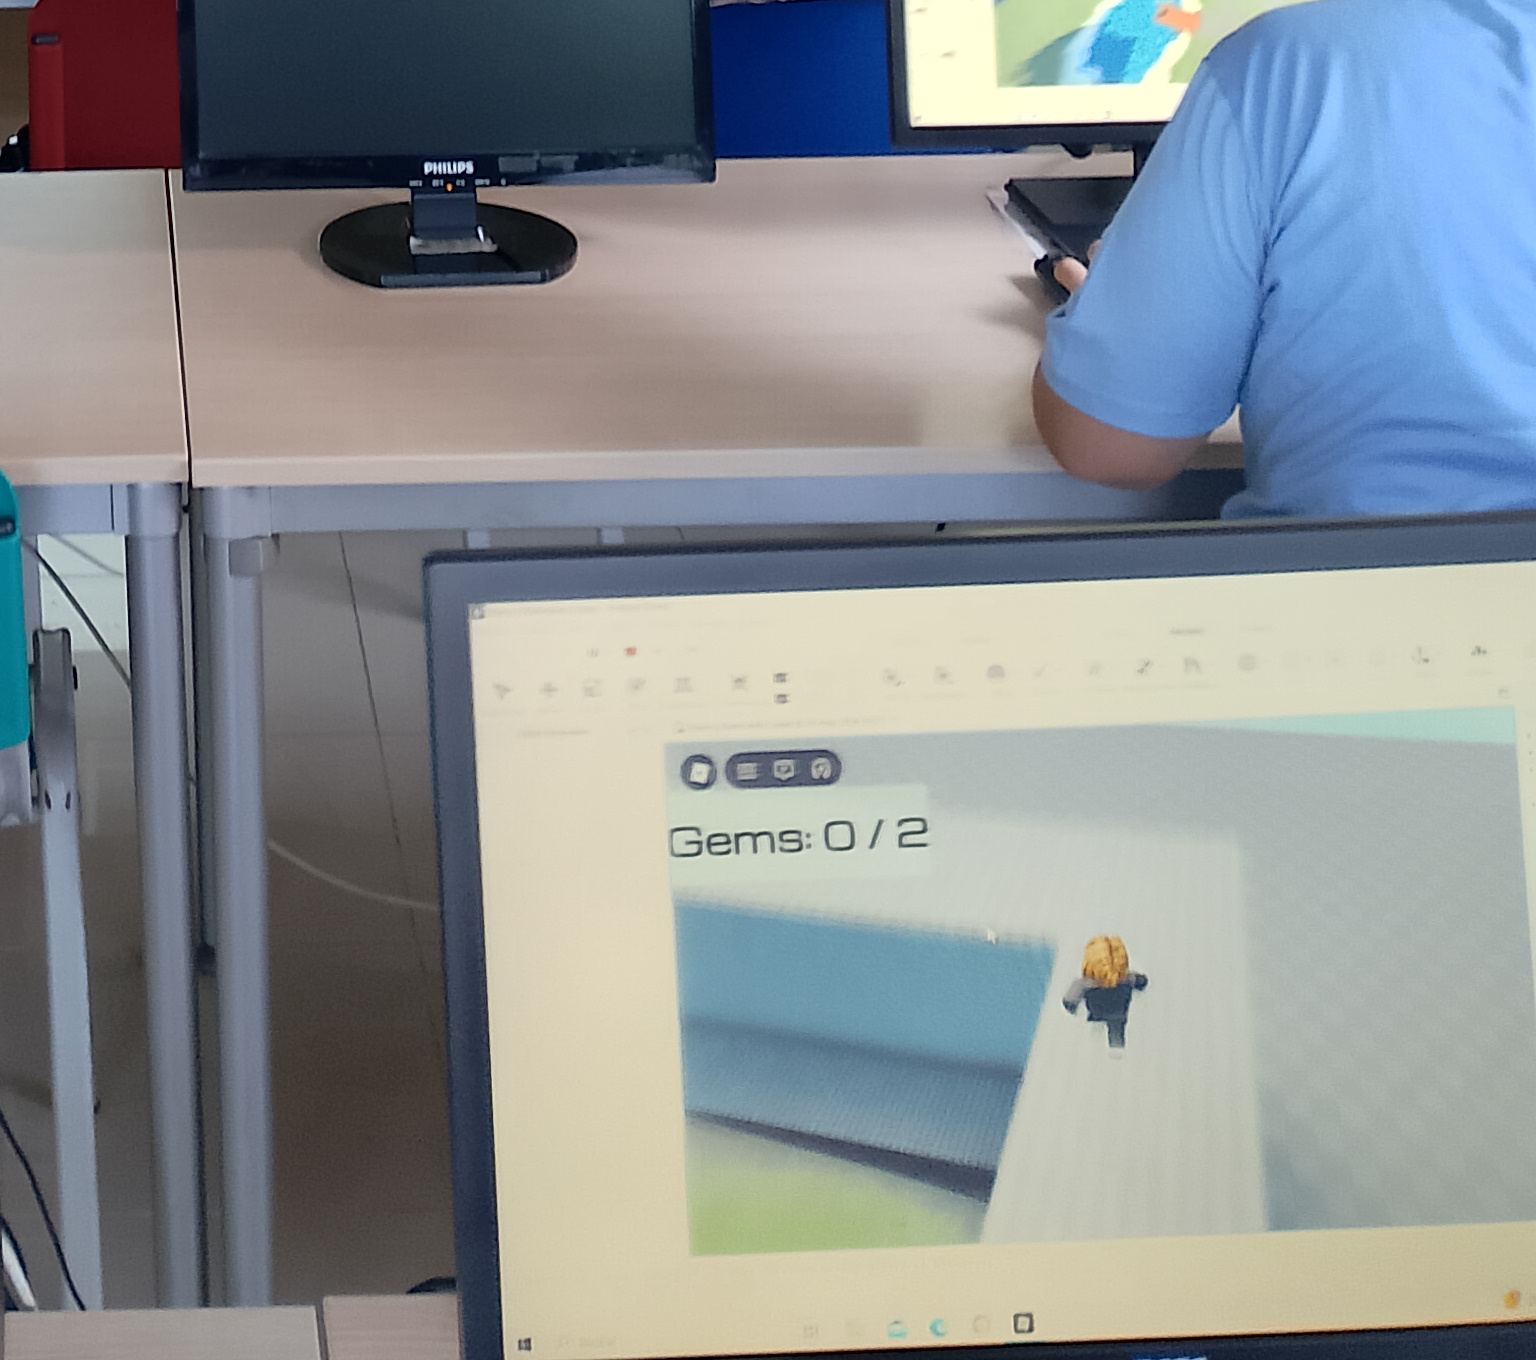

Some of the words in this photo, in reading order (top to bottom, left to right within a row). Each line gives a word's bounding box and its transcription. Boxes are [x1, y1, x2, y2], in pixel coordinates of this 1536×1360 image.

[424, 160, 474, 176] PHILIPS
[669, 826, 812, 858] Gems:
[824, 820, 856, 852] 0
[868, 819, 885, 850] /
[897, 817, 930, 849] 2
